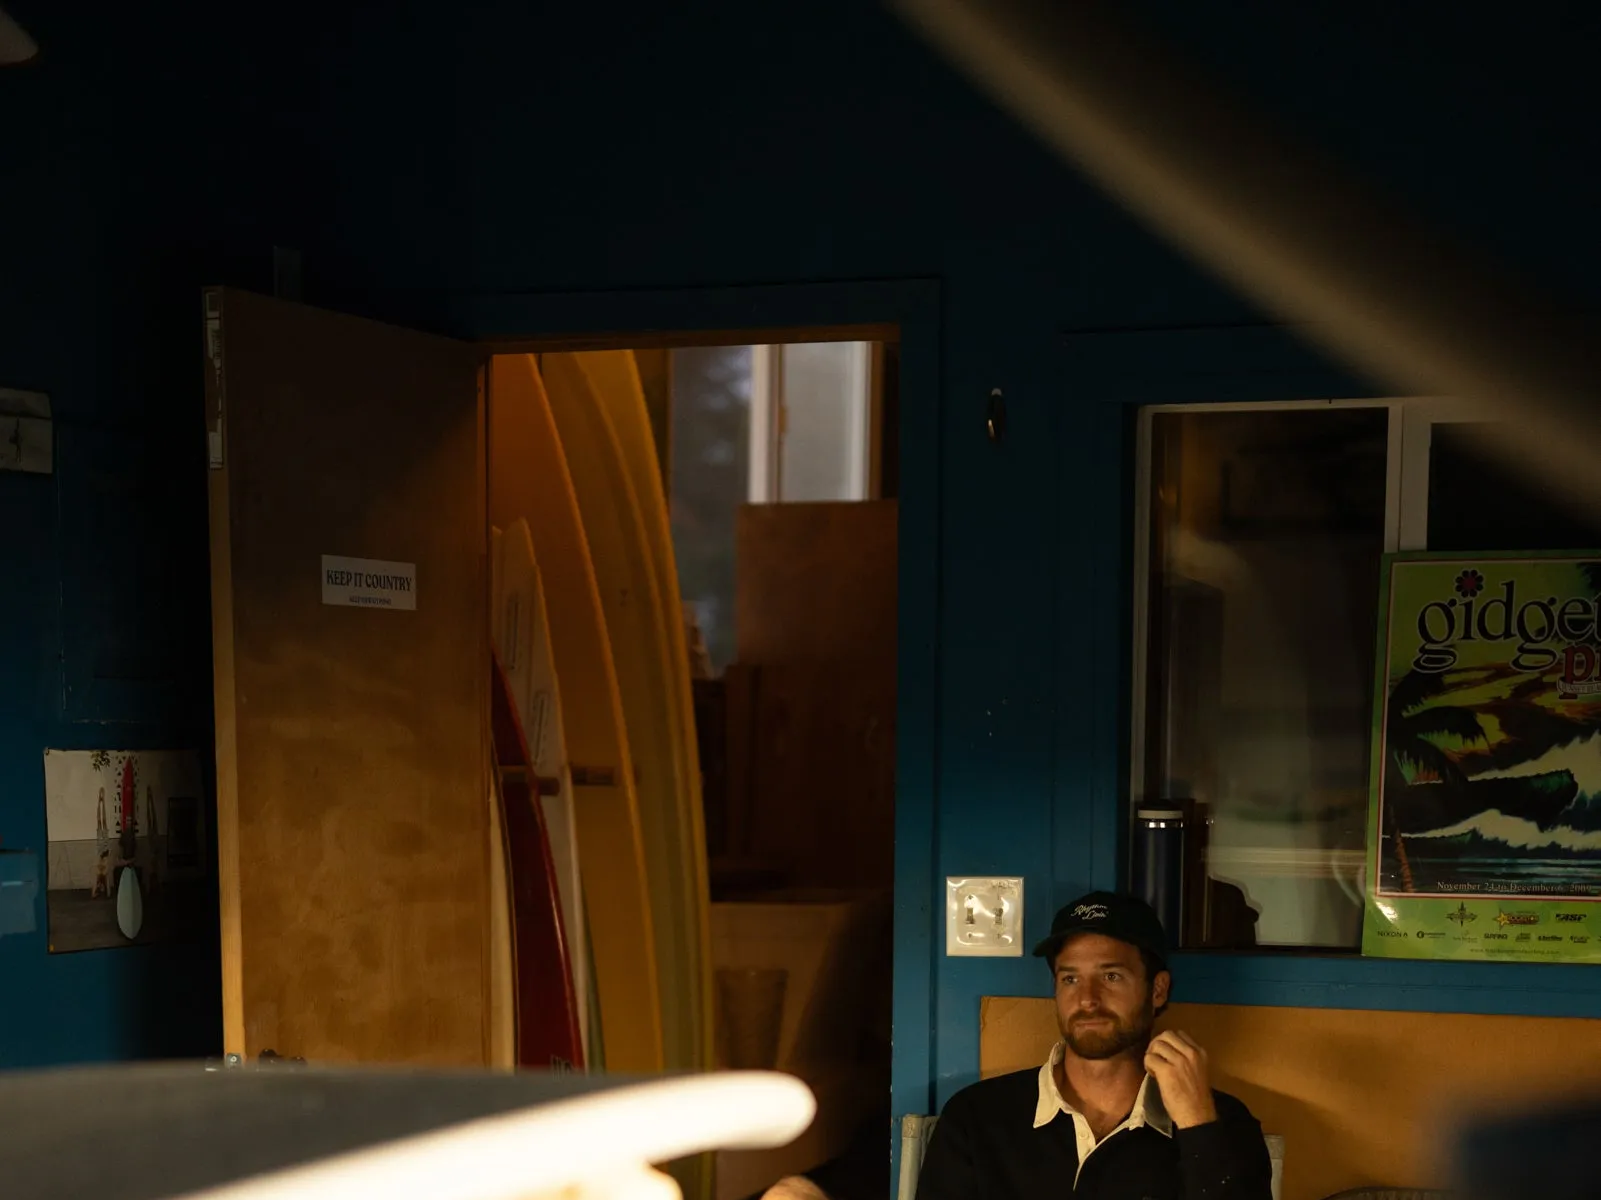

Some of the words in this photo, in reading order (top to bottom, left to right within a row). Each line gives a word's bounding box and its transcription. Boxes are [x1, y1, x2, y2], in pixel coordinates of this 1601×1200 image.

[326, 569, 353, 588] KEEP
[353, 572, 364, 588] IT
[365, 574, 412, 592] COUNTRY
[1437, 881, 1481, 892] November
[1510, 883, 1553, 893] December
